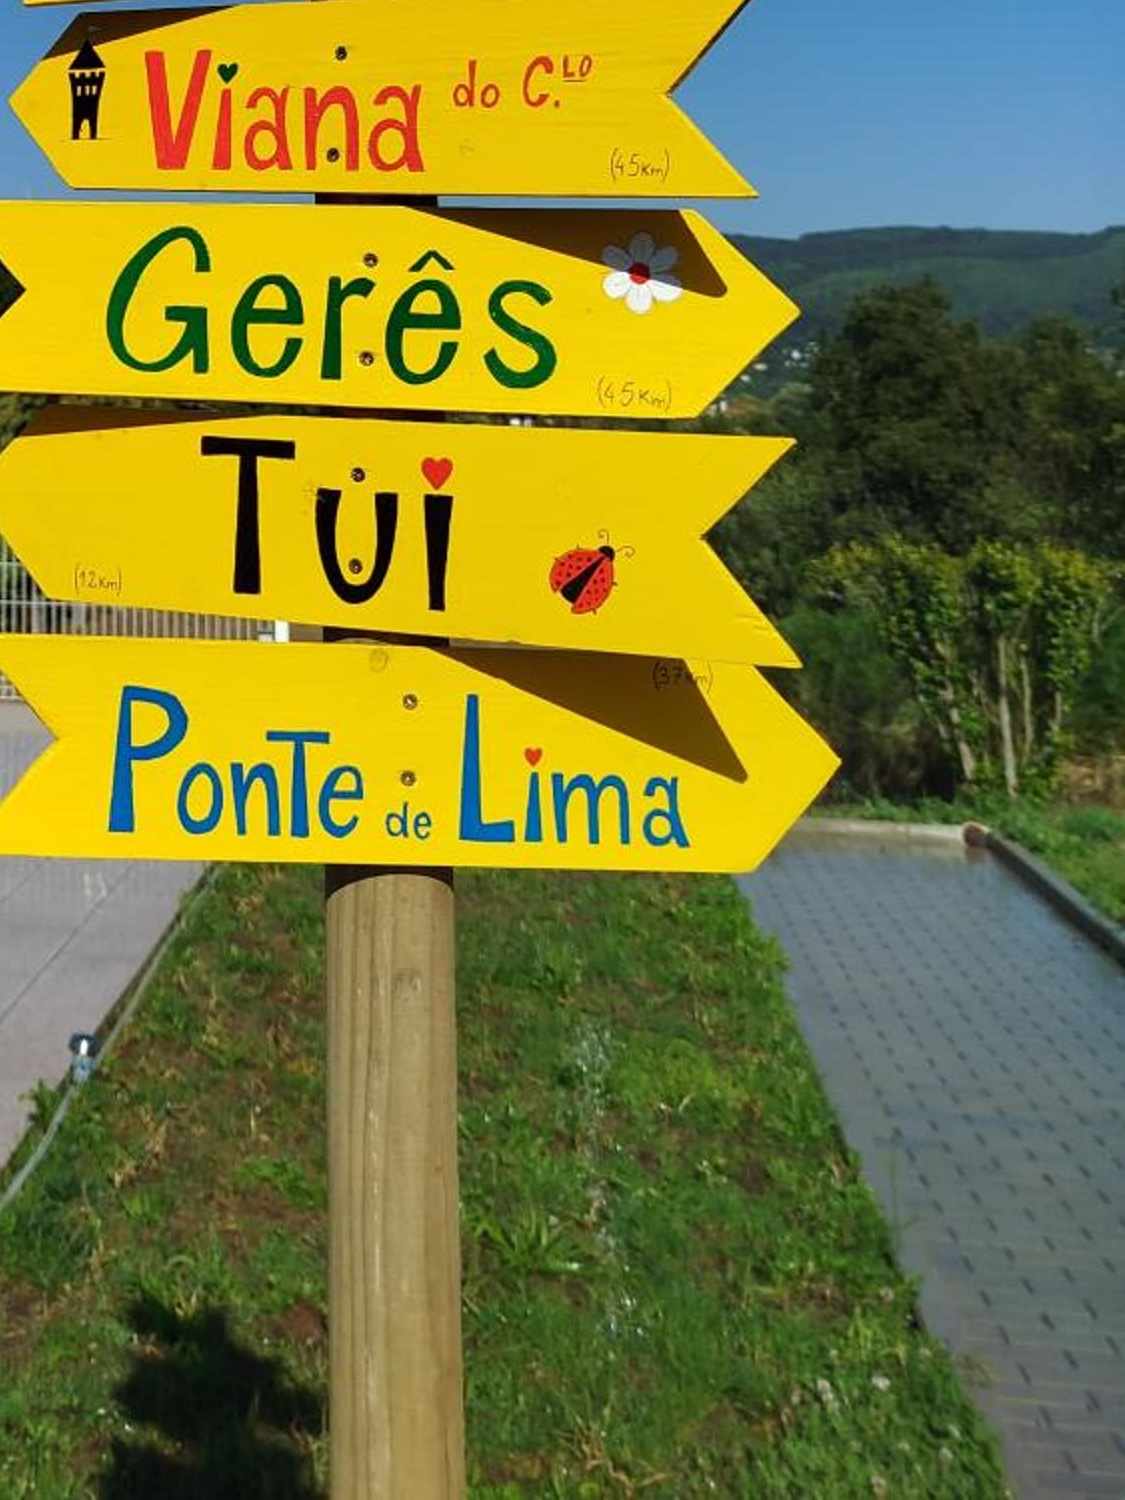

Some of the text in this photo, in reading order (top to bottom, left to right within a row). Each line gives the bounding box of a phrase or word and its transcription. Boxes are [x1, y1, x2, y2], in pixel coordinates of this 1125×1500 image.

[143, 48, 426, 173] Viana
[452, 59, 500, 108] do
[105, 225, 559, 390] Gerês
[384, 801, 434, 841] de
[458, 692, 692, 850] Lima
